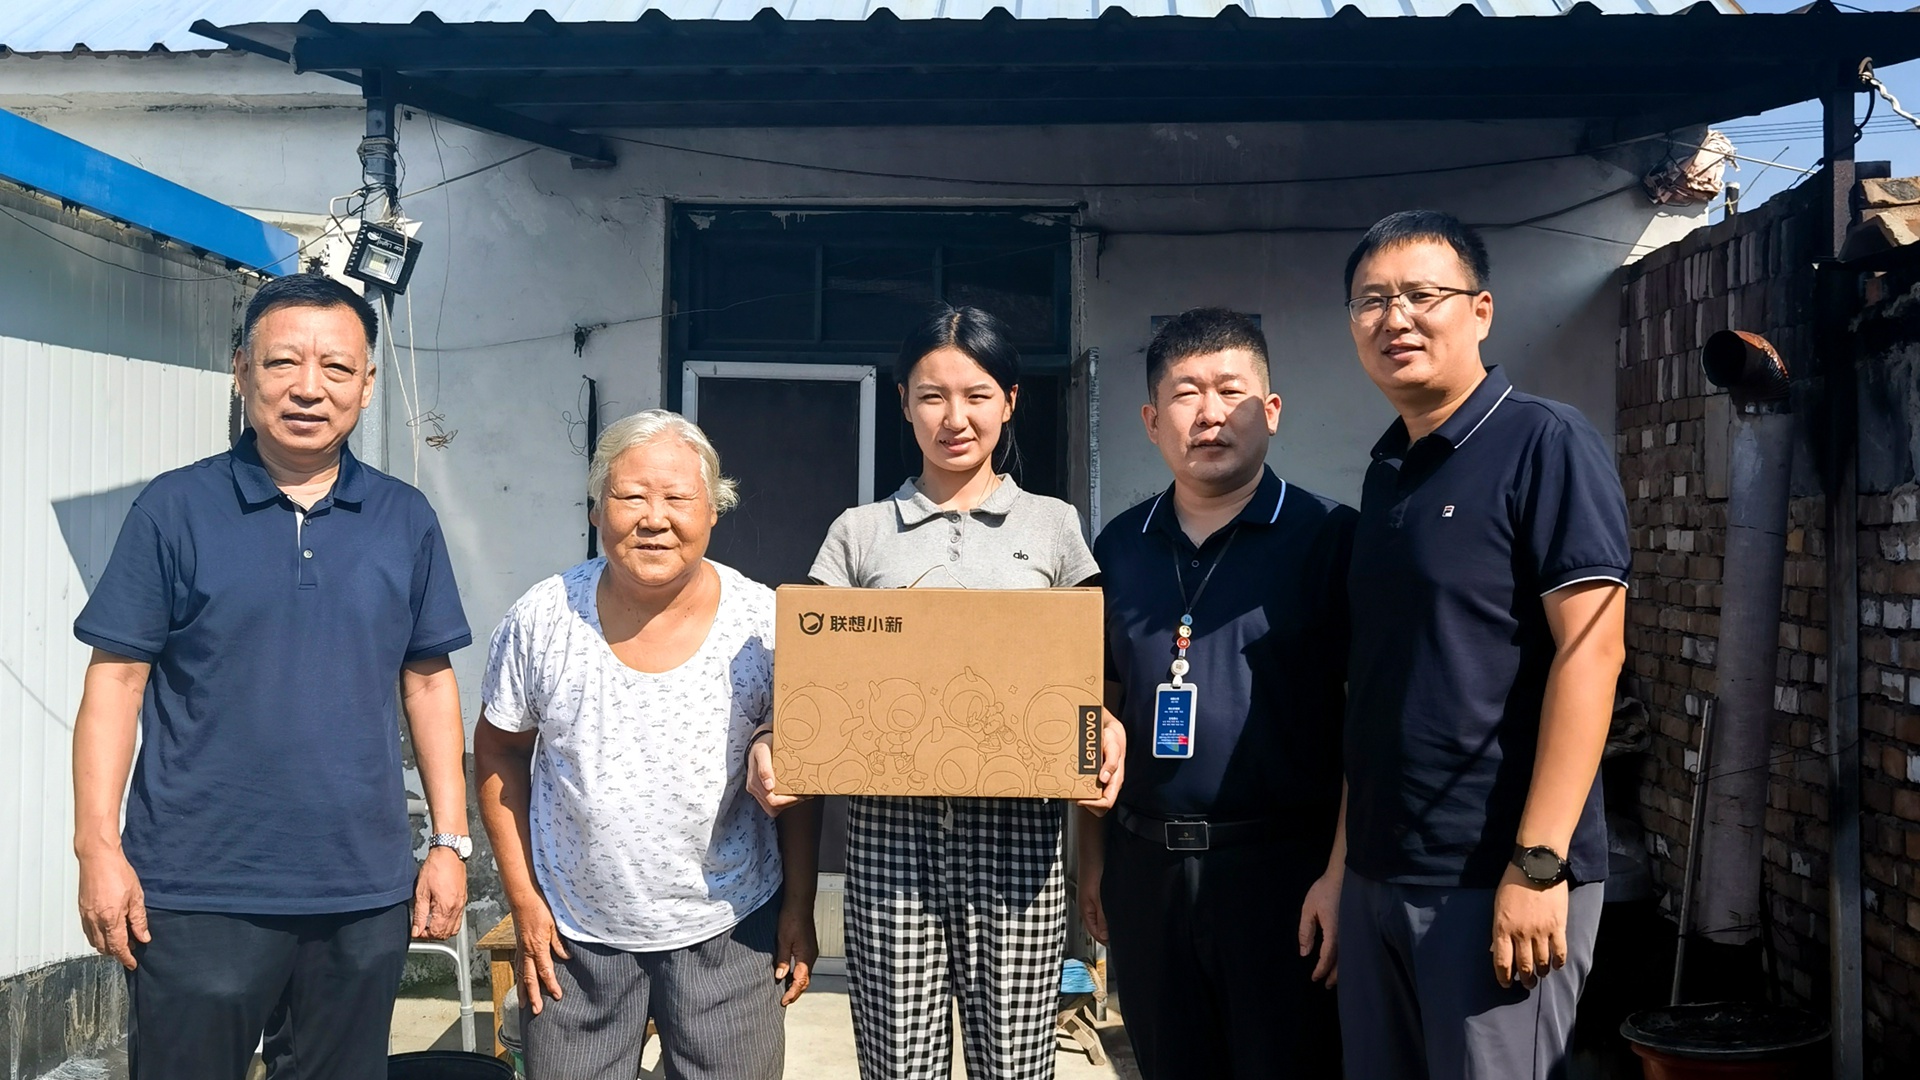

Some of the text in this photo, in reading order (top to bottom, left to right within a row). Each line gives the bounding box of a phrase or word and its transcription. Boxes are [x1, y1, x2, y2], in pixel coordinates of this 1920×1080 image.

[1013, 549, 1029, 561] alo
[829, 615, 903, 633] 联想小新
[1083, 710, 1097, 770] Lenovo
